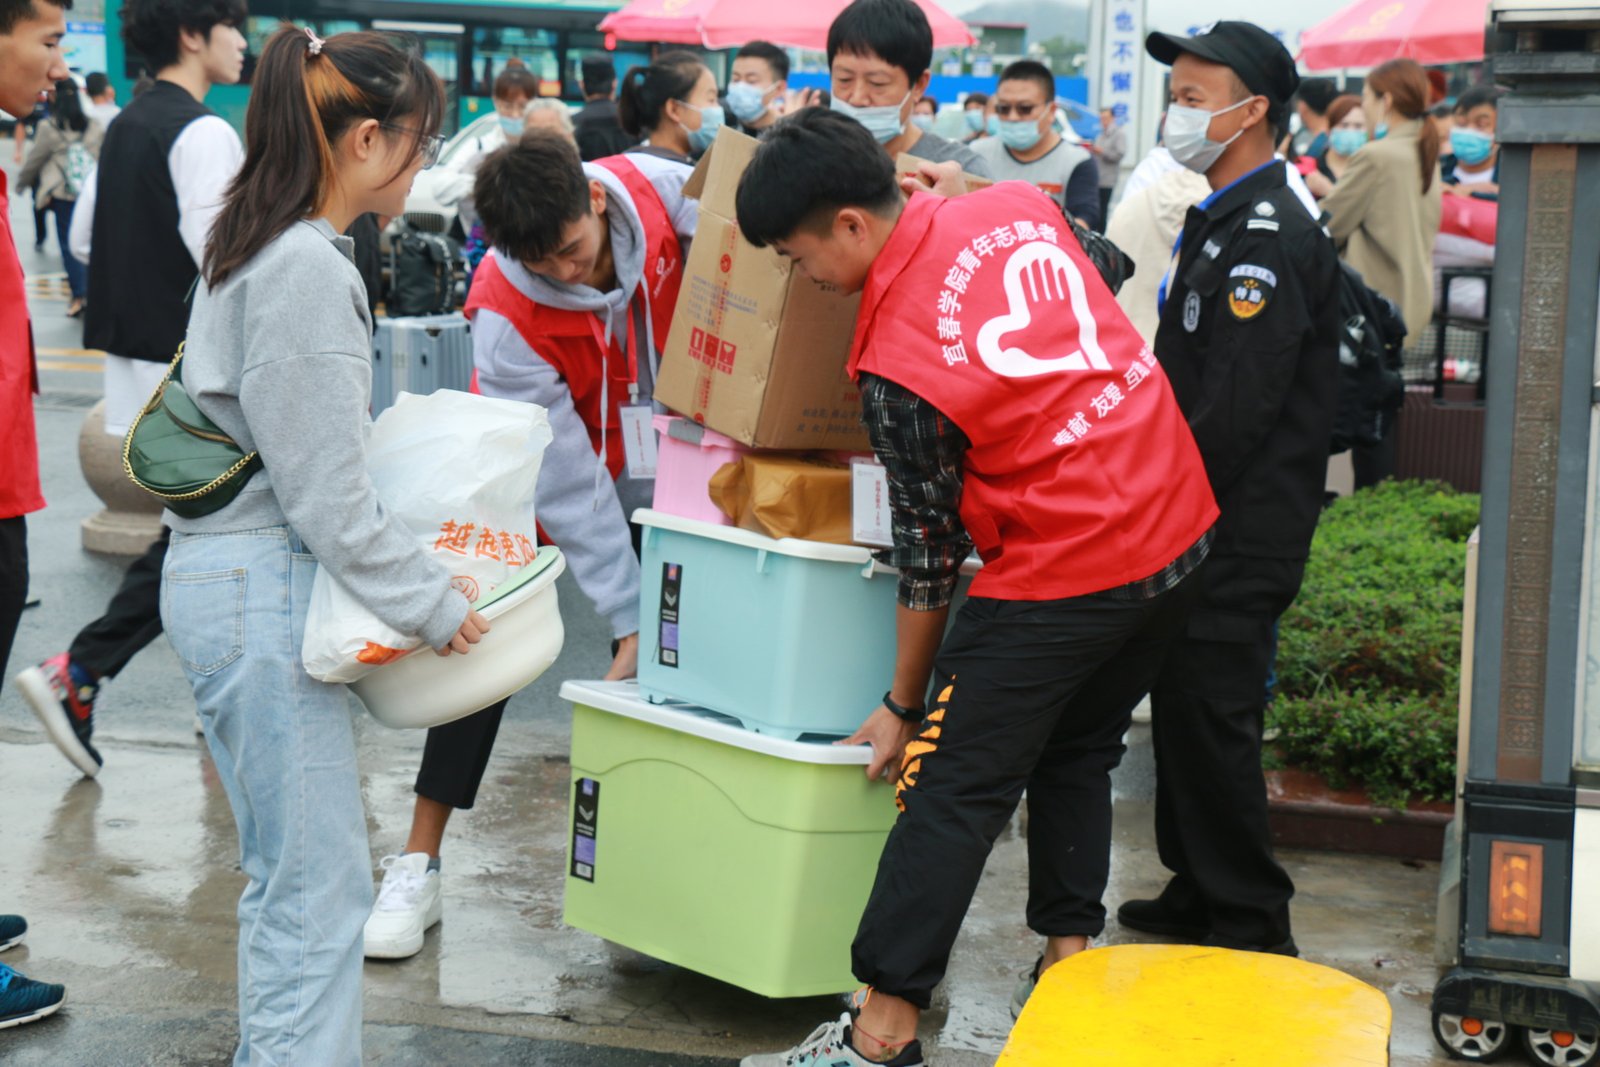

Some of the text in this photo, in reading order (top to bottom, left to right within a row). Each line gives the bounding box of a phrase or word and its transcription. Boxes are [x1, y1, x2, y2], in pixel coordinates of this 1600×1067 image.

[936, 220, 1058, 367] 宜春学院青年志愿者
[1052, 411, 1092, 447] 奉献
[1090, 381, 1126, 419] 友爱
